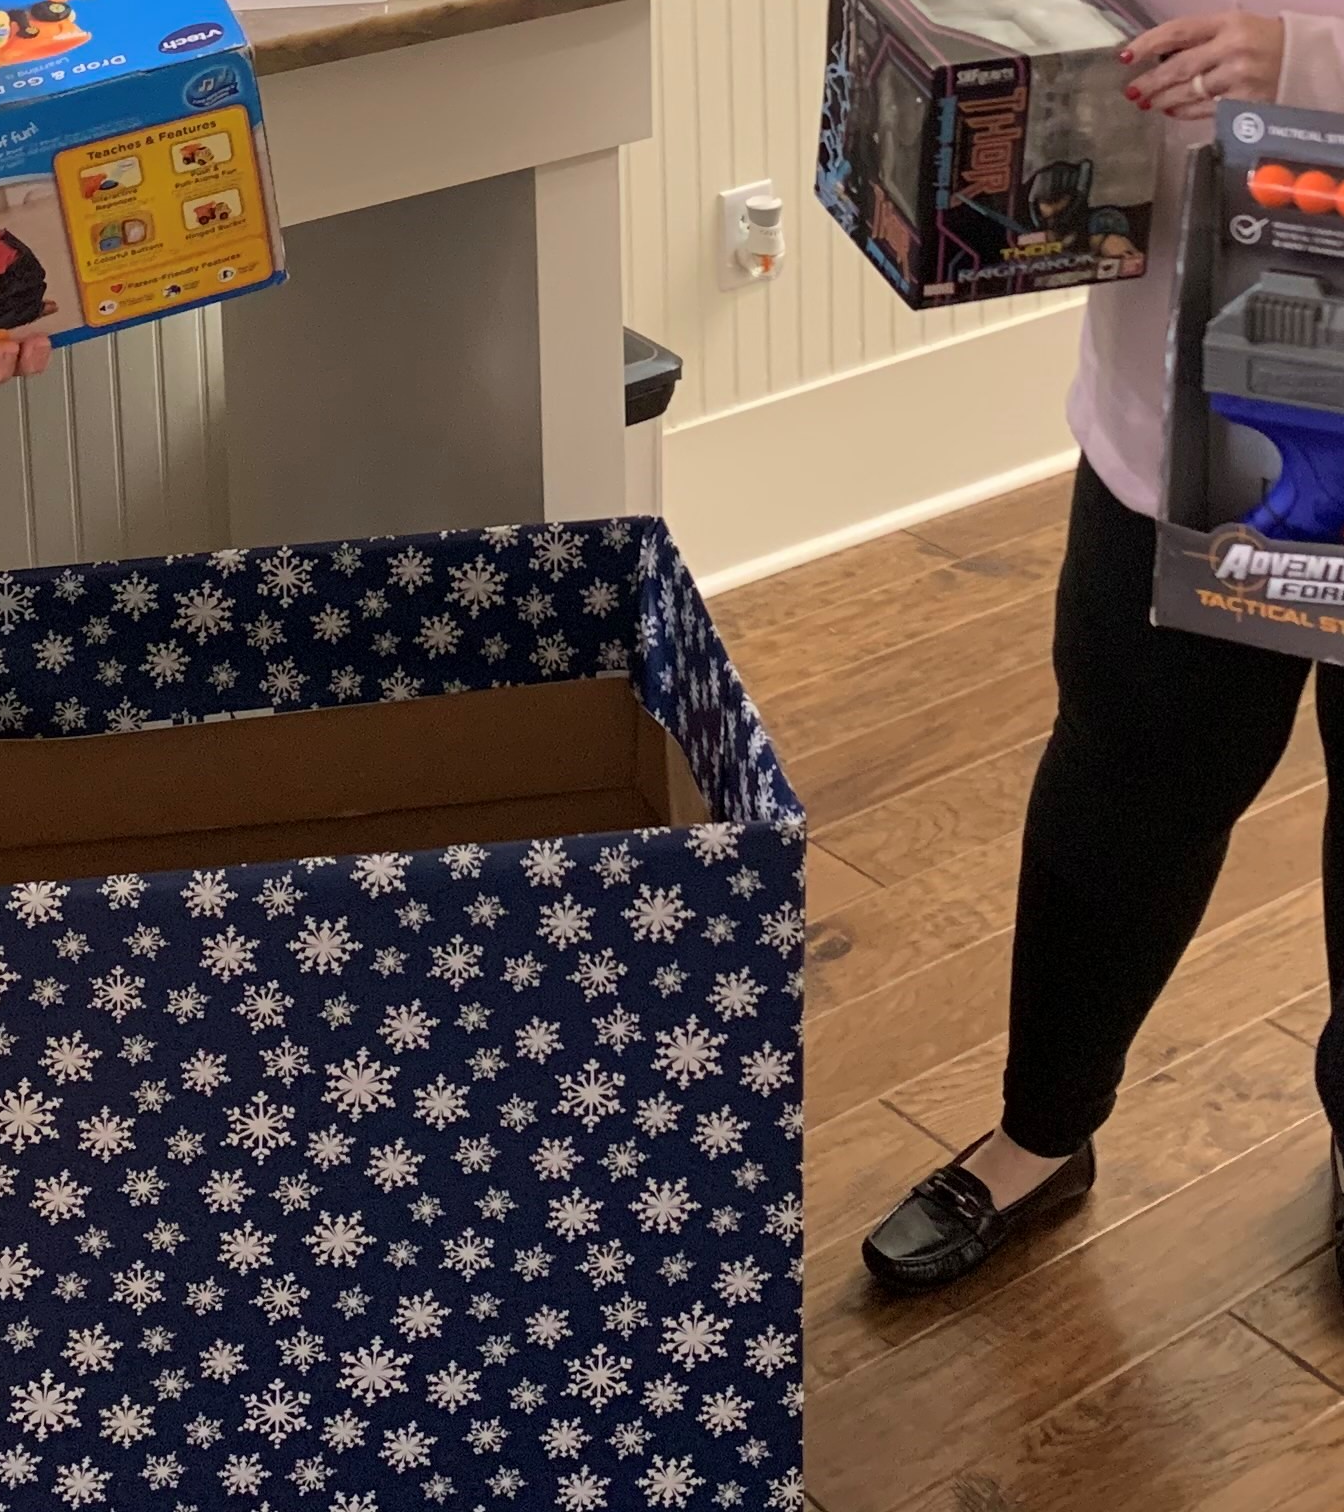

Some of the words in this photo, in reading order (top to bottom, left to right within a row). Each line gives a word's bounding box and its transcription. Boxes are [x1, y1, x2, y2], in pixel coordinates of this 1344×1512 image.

[163, 29, 222, 49] vtech
[72, 55, 126, 75] Drop
[13, 76, 45, 89] Go
[51, 70, 65, 81] &
[10, 122, 39, 144] fun!
[87, 140, 142, 160] Teaches
[145, 136, 155, 145] &
[158, 120, 217, 141] Features
[1268, 126, 1322, 143] TACTICAL
[950, 86, 1027, 208] THOR
[185, 227, 216, 240] Hinged
[218, 218, 246, 232] Bucket
[94, 251, 129, 265] Colorful
[131, 242, 164, 256] Buttons
[1000, 241, 1062, 260] THOR
[202, 252, 241, 270] Features
[1196, 588, 1315, 628] TACTICAL
